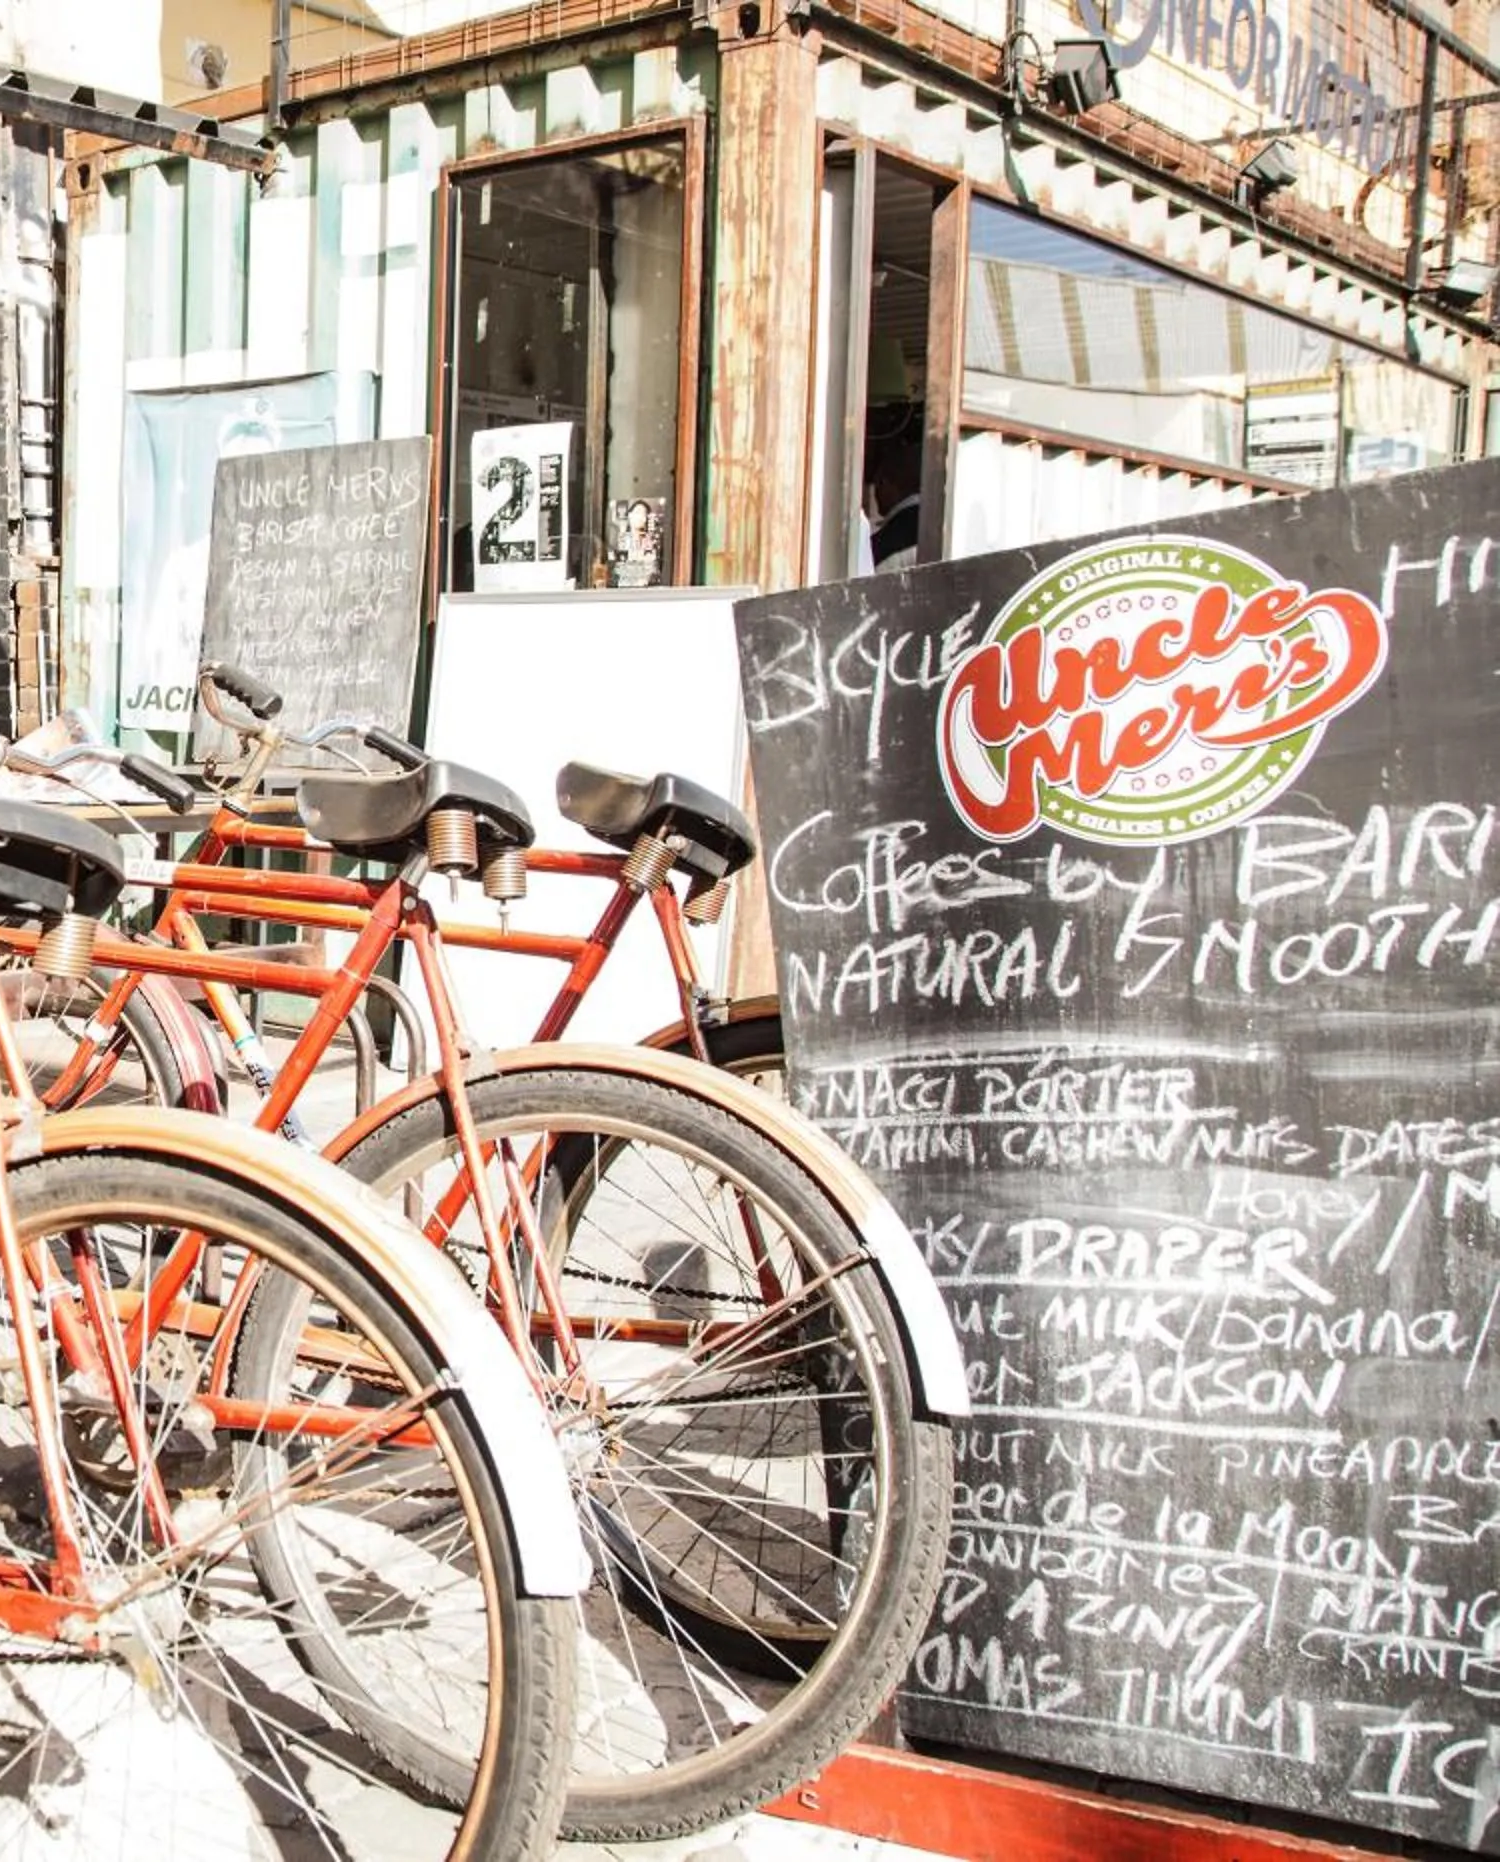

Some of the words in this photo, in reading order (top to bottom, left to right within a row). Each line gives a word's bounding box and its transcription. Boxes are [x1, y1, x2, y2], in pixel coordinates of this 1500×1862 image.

[238, 474, 310, 509] UNCLE
[1058, 549, 1184, 593] ORIGINAL
[746, 602, 980, 765] BICYCLE
[956, 584, 1304, 745] Uncle
[1046, 845, 1168, 962] by
[784, 920, 1081, 1017] NATURAL
[1006, 1216, 1337, 1304] DRAPER
[1055, 1354, 1346, 1418] JACKSON
[1045, 1431, 1176, 1481] MILK
